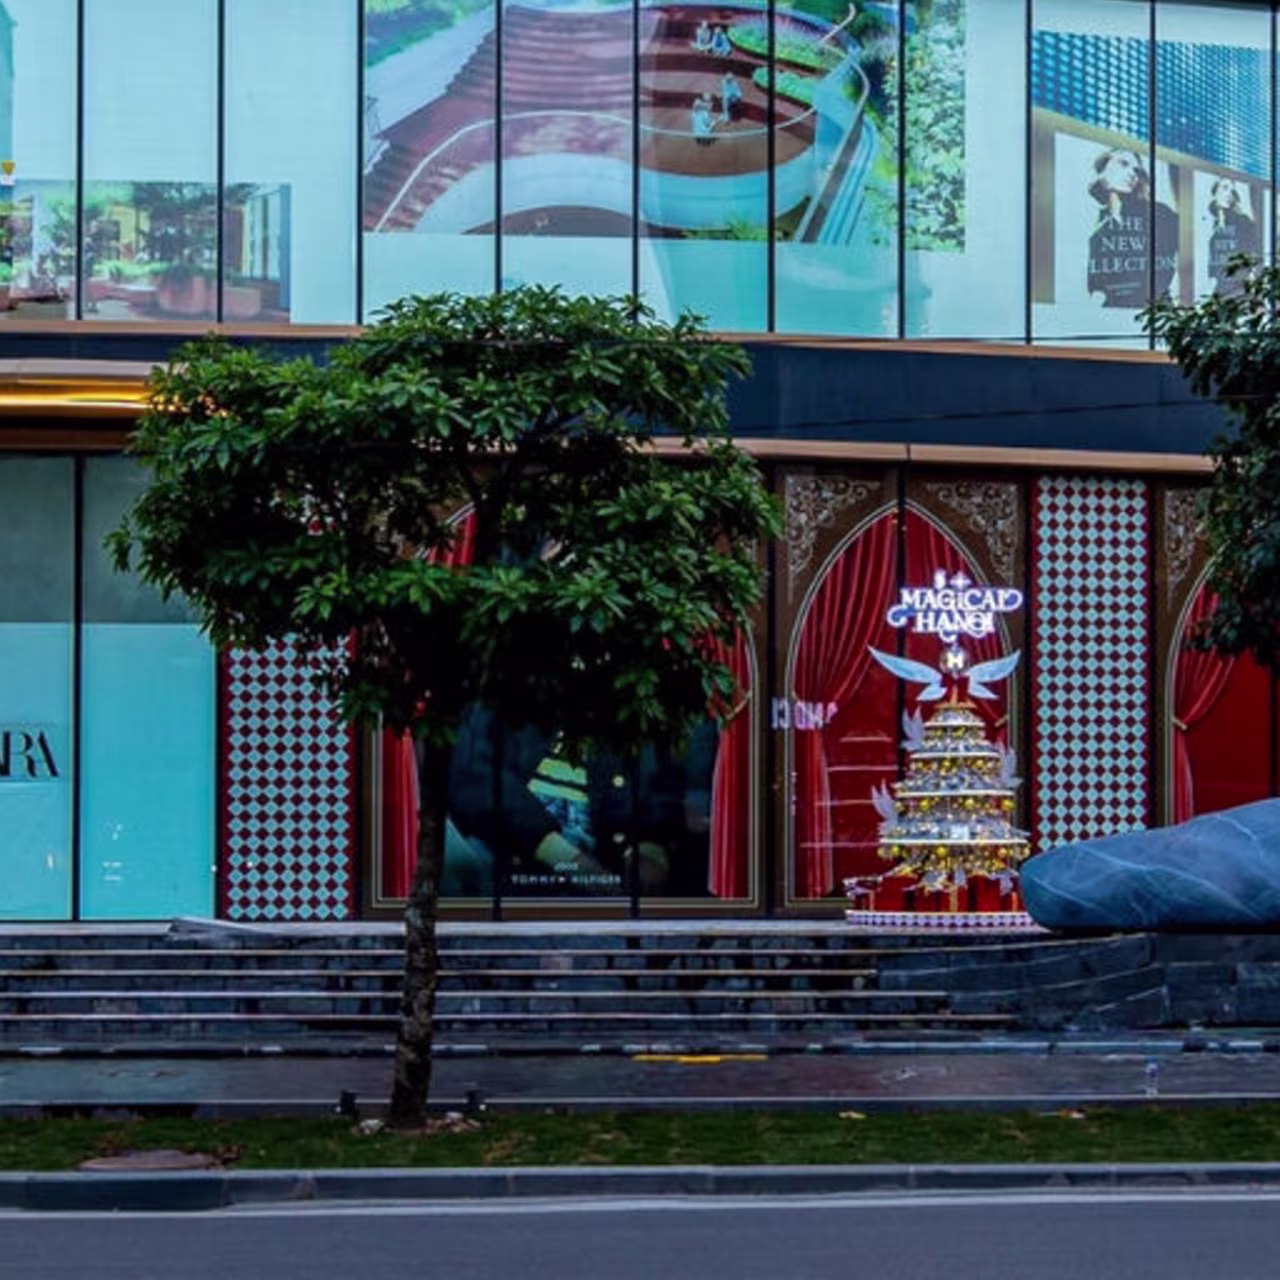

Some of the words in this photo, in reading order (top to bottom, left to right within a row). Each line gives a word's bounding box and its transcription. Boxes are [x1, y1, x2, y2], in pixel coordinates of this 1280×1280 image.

[1104, 215, 1144, 231] THE
[1101, 236, 1146, 252] NEW
[912, 610, 996, 642] HANOI
